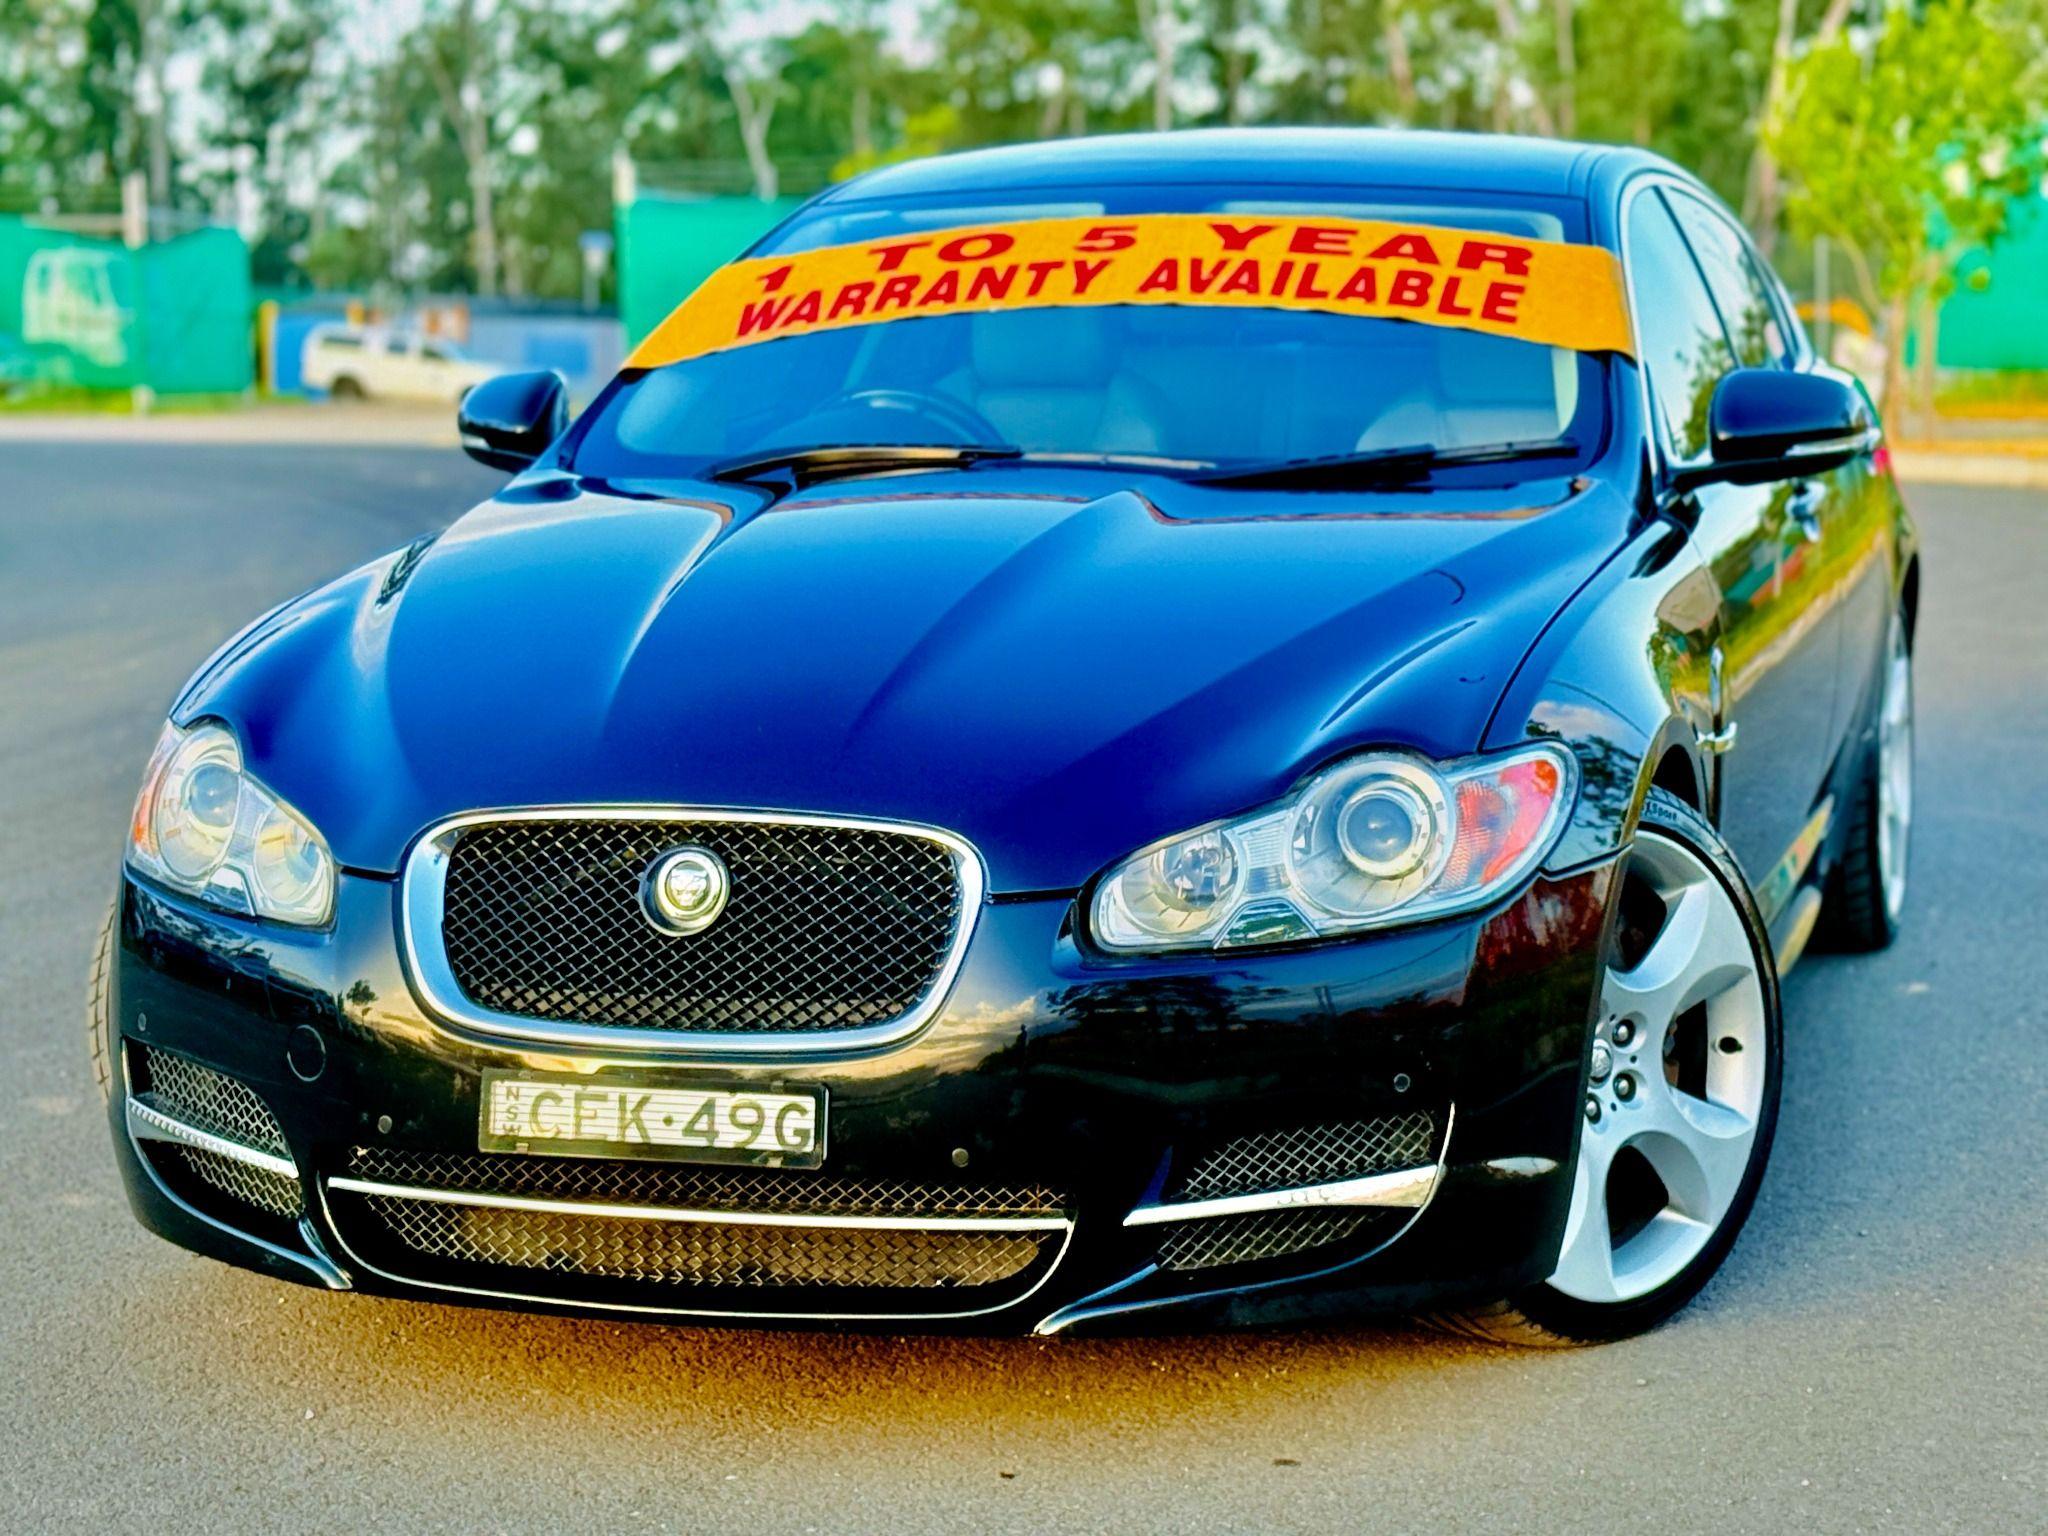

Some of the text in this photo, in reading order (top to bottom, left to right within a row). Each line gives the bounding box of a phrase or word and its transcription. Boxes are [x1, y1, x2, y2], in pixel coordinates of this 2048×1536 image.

[758, 222, 1534, 294] 1 TO 5 YEAR
[736, 256, 1527, 338] WARRANTY AVAILABLE
